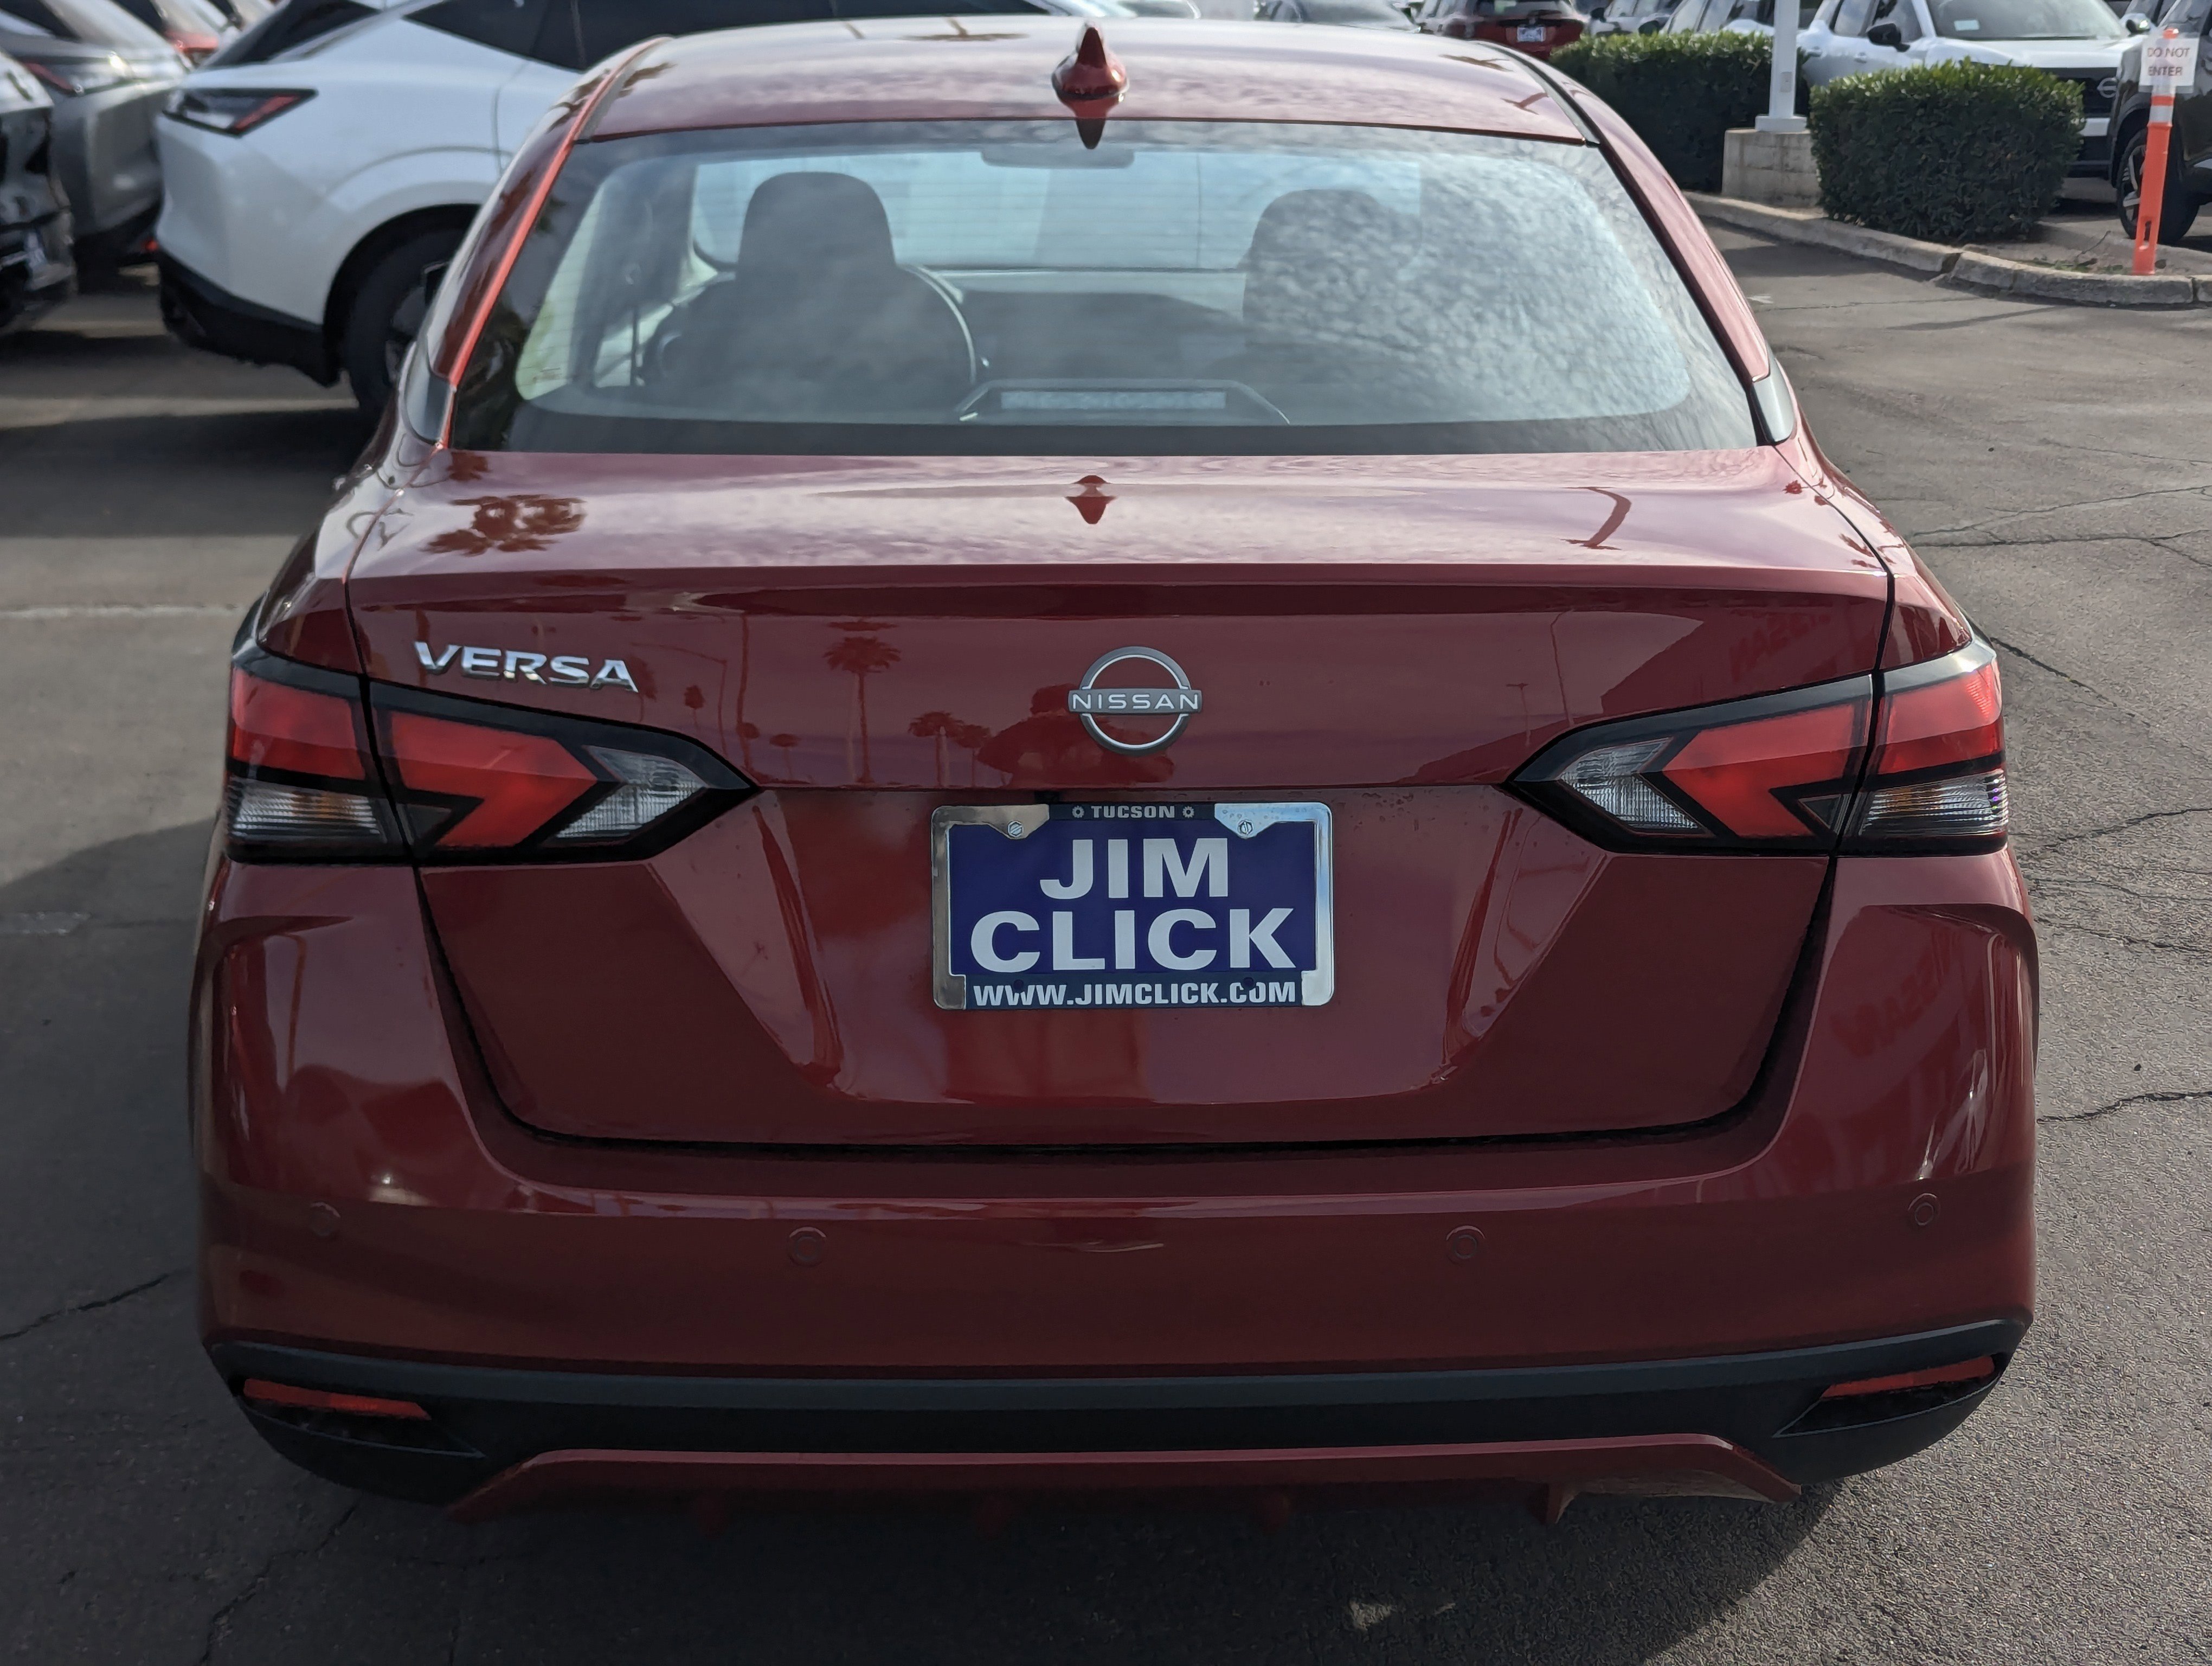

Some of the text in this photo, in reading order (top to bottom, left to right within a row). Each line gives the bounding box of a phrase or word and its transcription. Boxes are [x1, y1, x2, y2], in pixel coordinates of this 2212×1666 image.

[2147, 47, 2190, 58] DO NOT
[2147, 66, 2183, 76] ENTER
[414, 640, 639, 693] VERSA
[1072, 694, 1199, 709] NISSAN
[1090, 805, 1175, 818] TUCSON
[1039, 837, 1229, 900] JIM
[970, 907, 1296, 973] CLICK
[973, 982, 1296, 1006] WWW.JIMCLICK.COM
